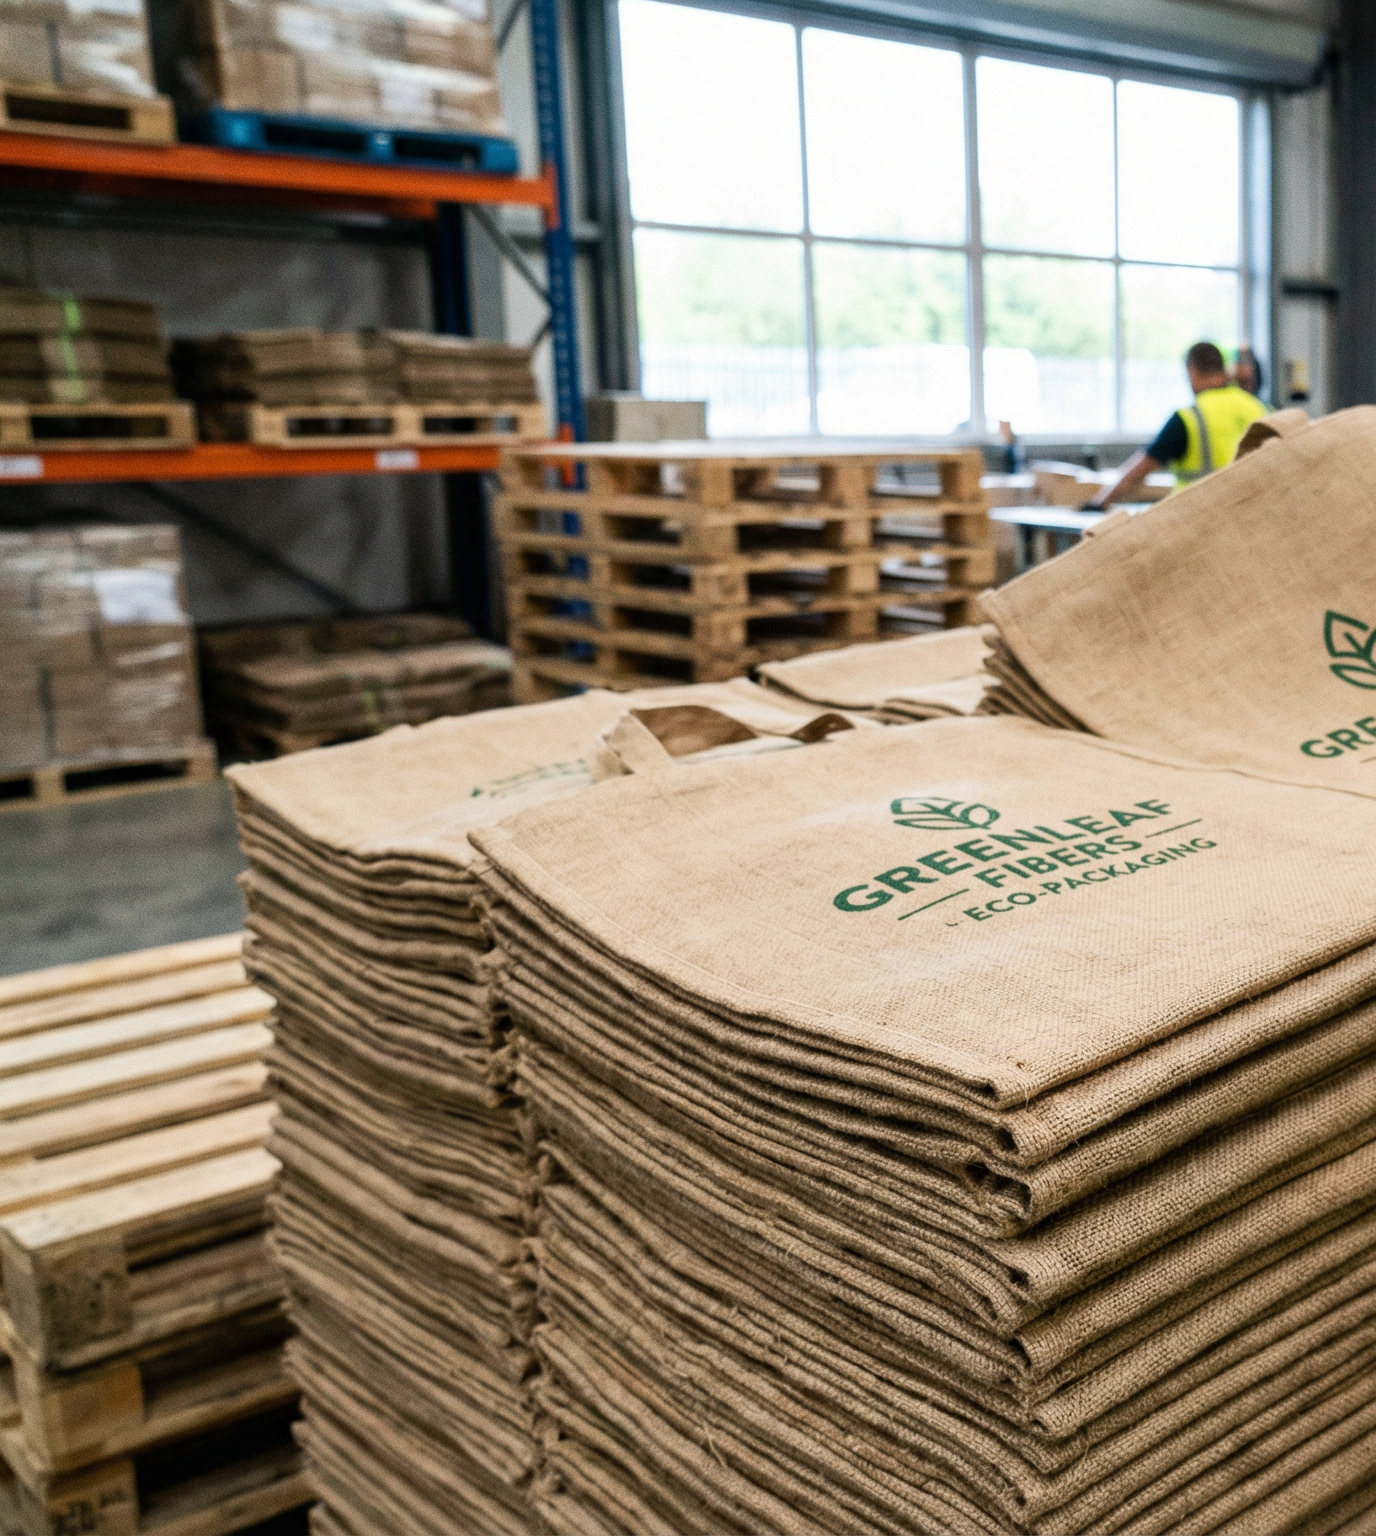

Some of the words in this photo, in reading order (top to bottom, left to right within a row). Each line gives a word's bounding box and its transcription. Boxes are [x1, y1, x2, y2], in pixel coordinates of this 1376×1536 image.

[832, 798, 1173, 913] GREENLEAF
[963, 837, 1218, 922] ECO-PACKAGING
[973, 835, 1143, 889] FIBERS
